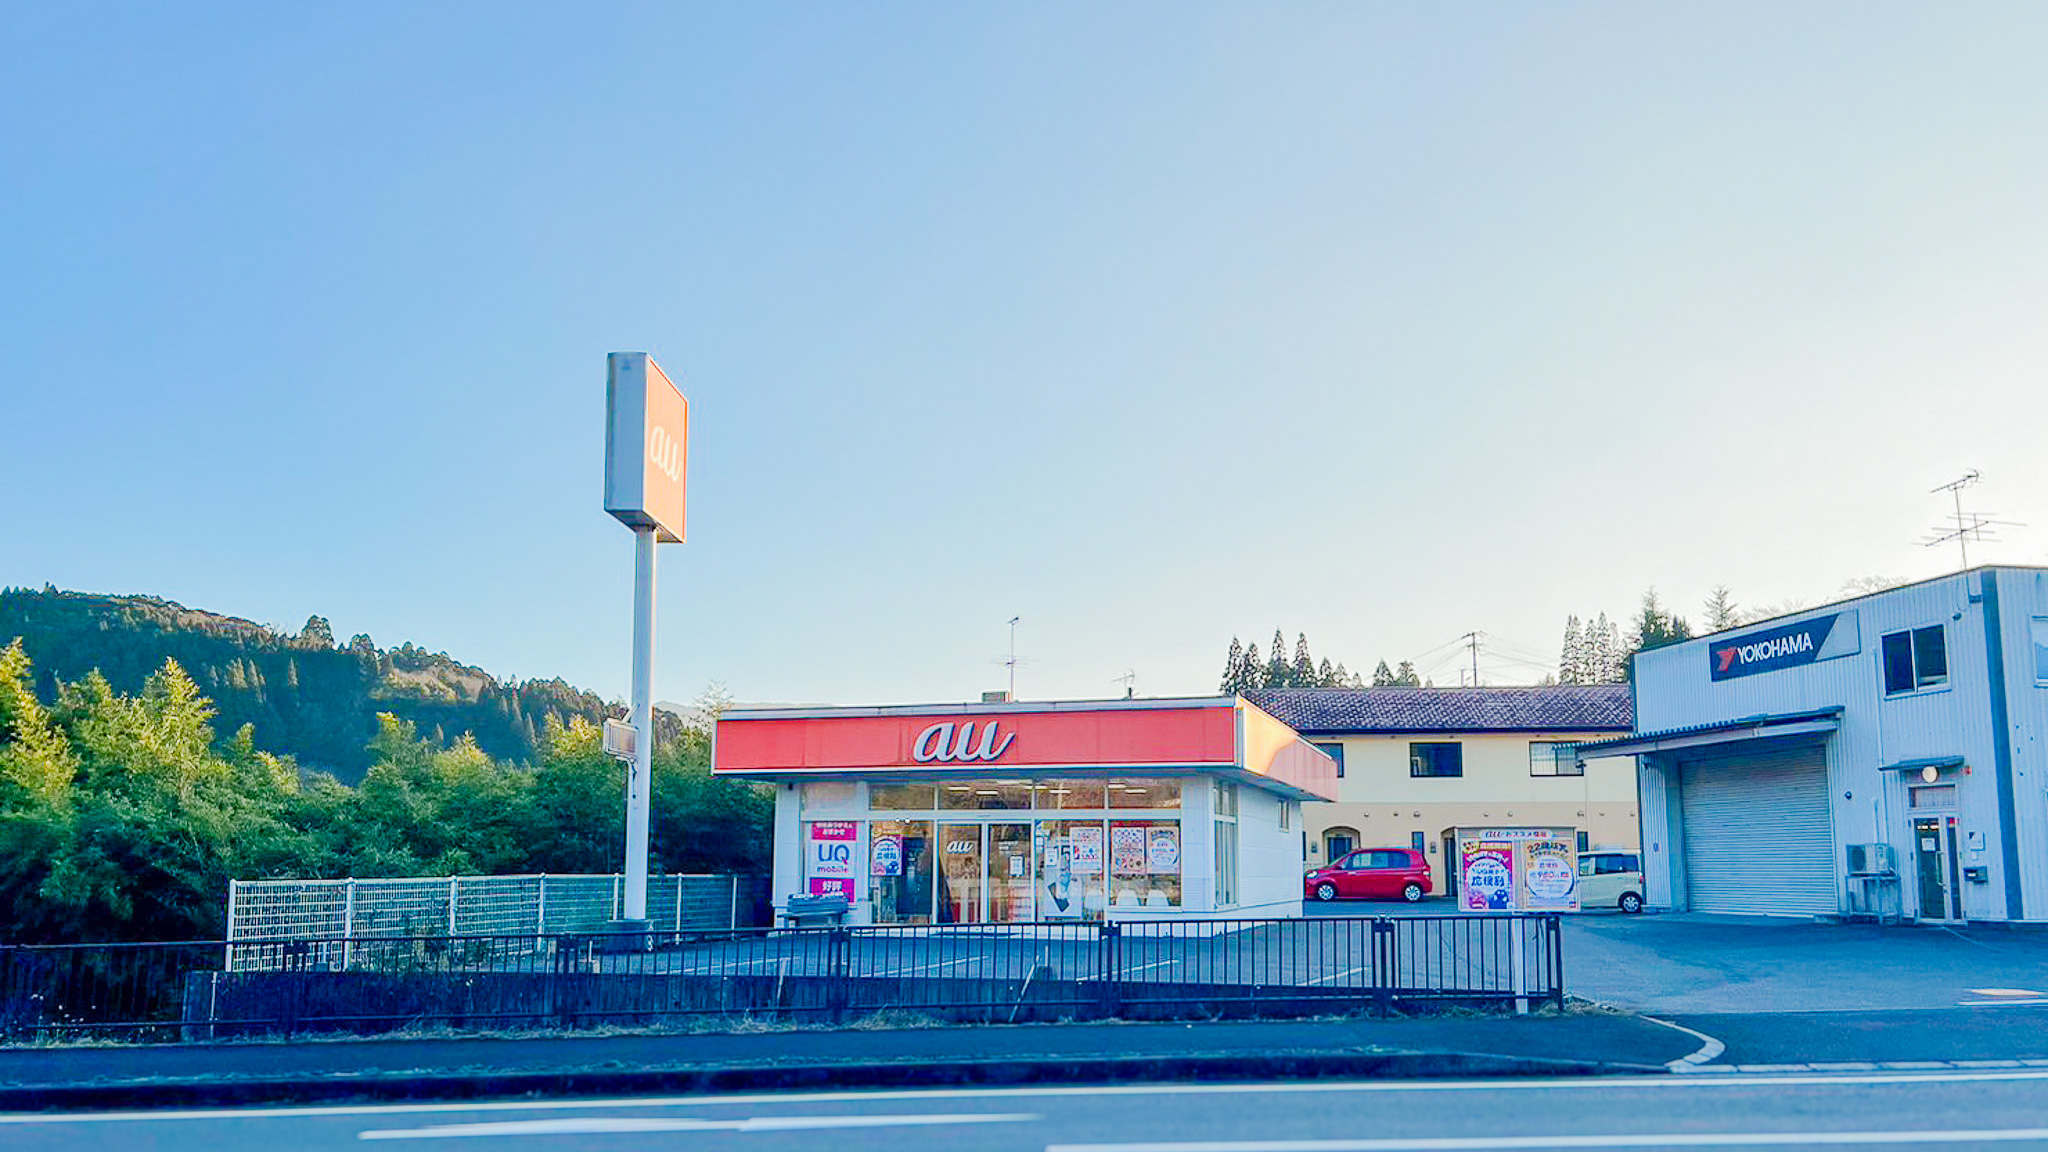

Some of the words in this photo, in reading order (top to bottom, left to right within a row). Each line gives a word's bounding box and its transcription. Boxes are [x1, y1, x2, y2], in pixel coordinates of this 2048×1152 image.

[650, 426, 682, 483] au
[1736, 632, 1813, 665] YOKOHAMA
[914, 721, 1016, 763] au
[818, 843, 850, 865] UQ
[946, 840, 974, 853] au
[816, 865, 849, 873] mobile
